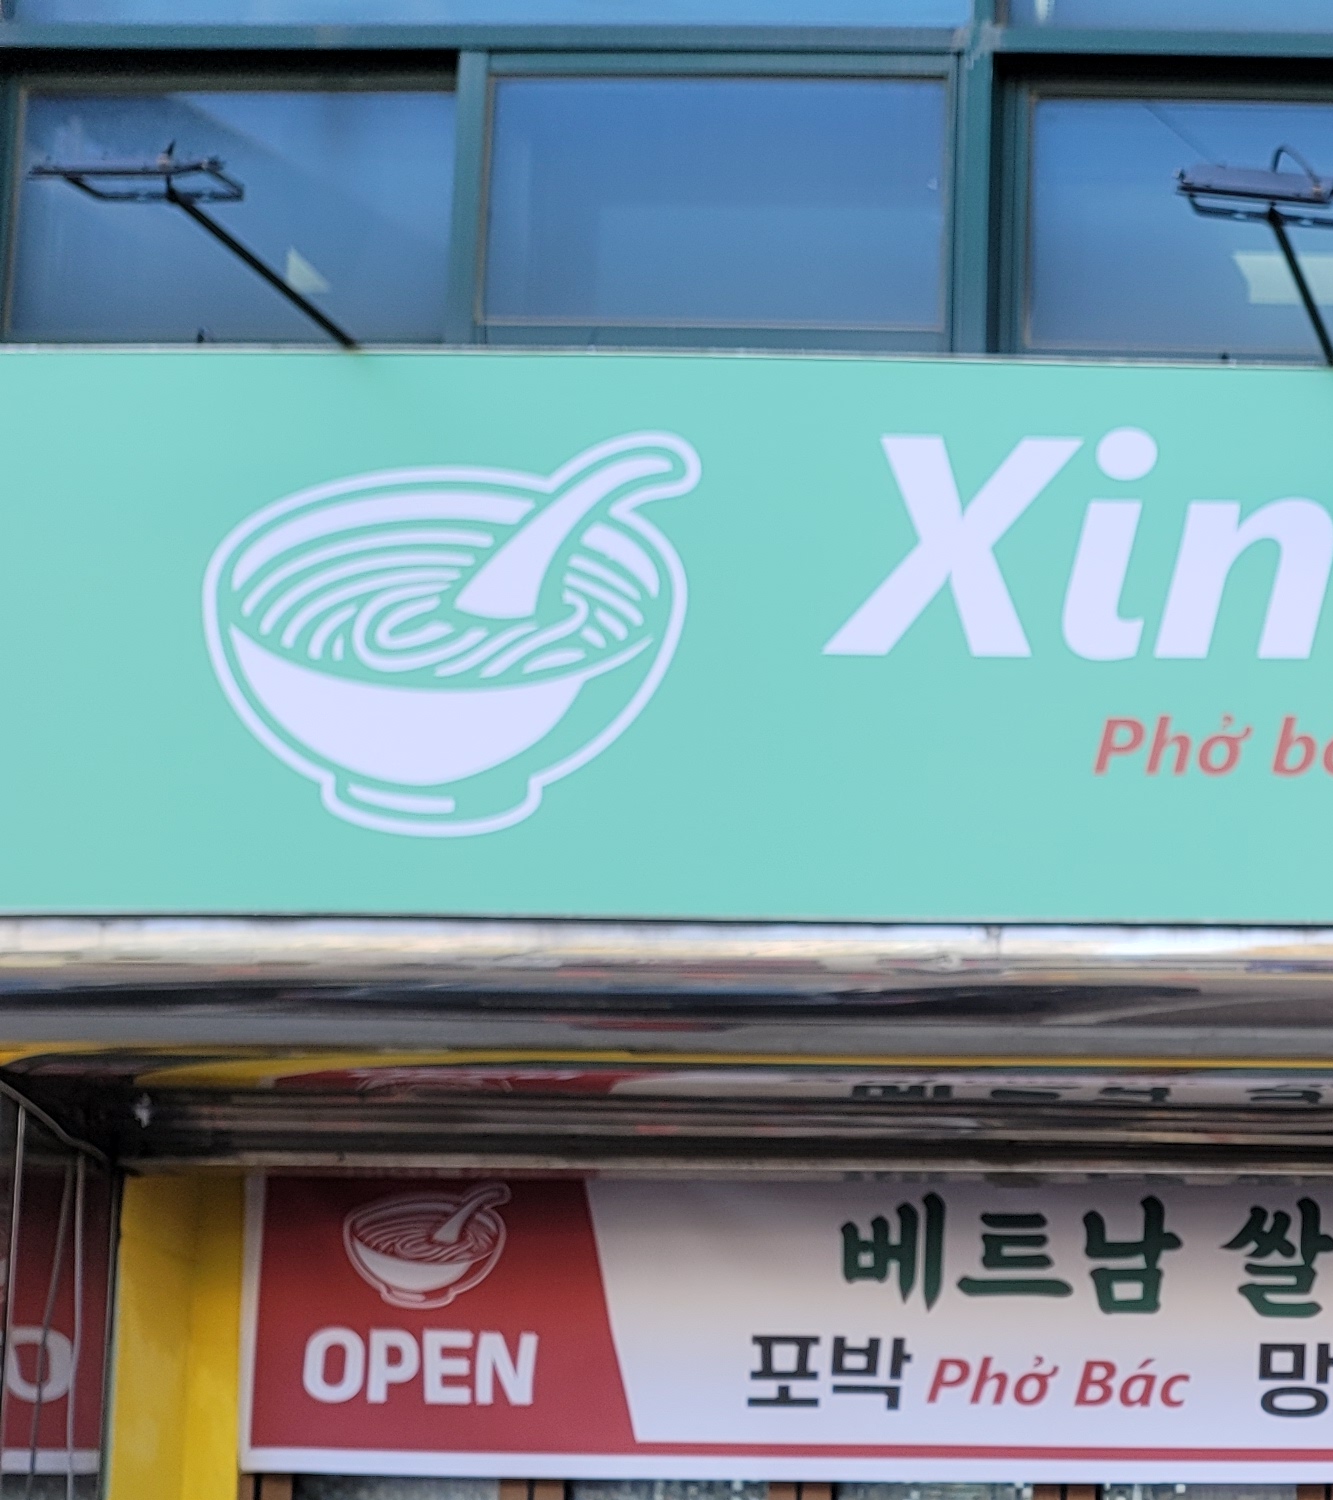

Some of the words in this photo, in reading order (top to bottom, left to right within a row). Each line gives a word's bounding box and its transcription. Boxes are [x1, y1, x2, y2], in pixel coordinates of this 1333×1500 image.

[1094, 715, 1252, 775] Phở
[840, 1192, 1183, 1315] 베트남
[304, 1328, 537, 1405] OPEN
[748, 1336, 911, 1409] 포박
[928, 1357, 1058, 1405] Phở
[1075, 1359, 1189, 1407] Bác
